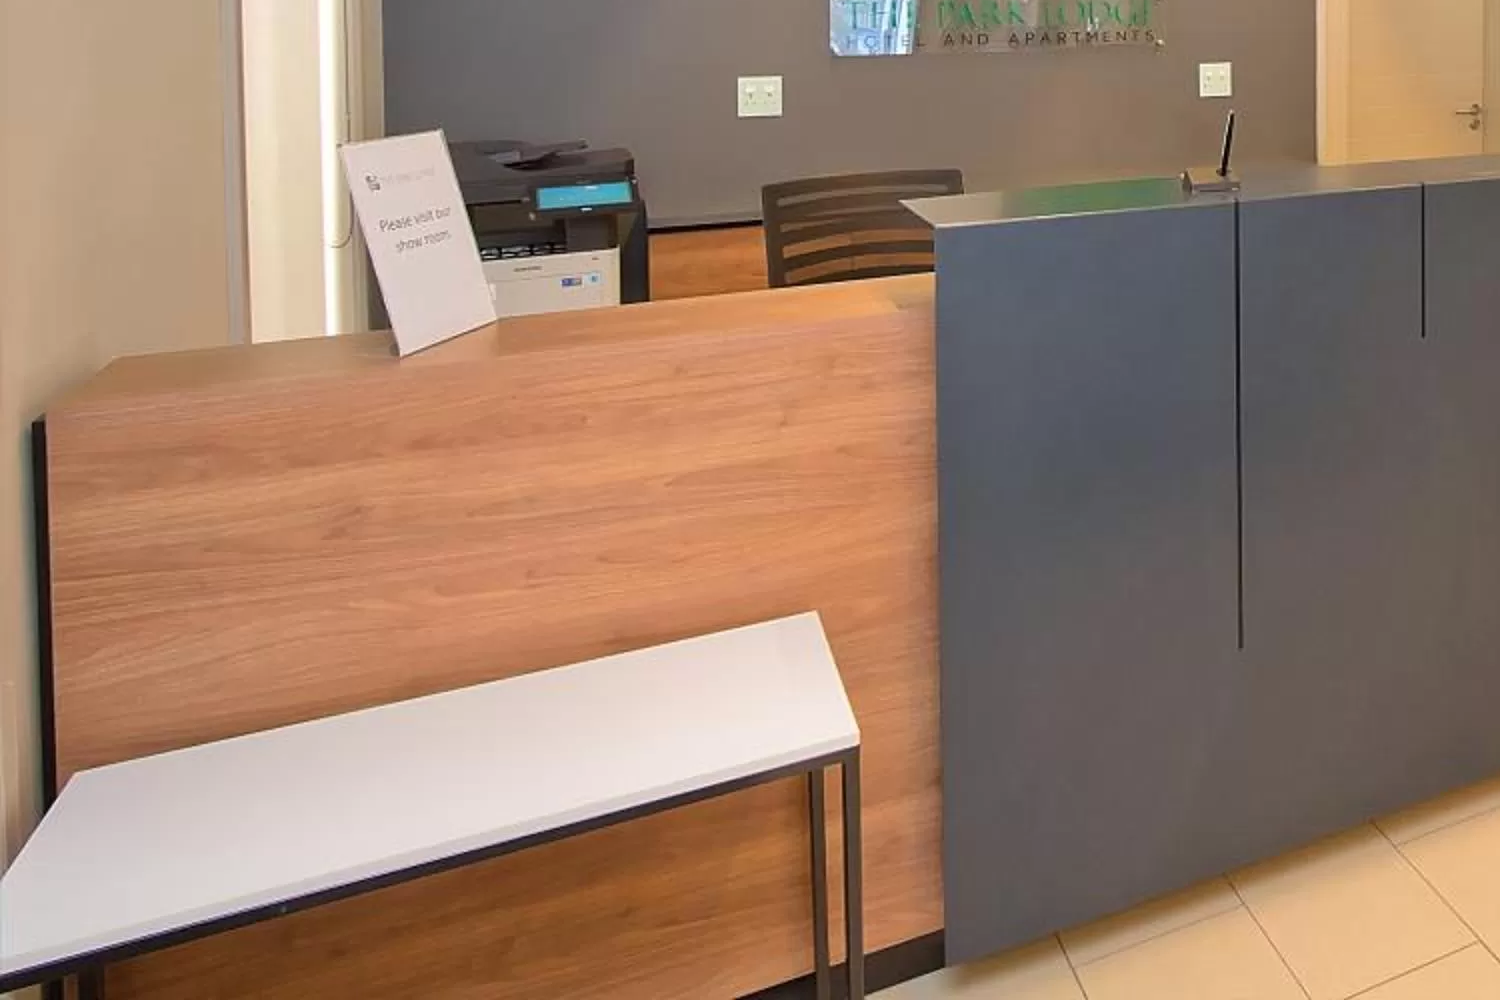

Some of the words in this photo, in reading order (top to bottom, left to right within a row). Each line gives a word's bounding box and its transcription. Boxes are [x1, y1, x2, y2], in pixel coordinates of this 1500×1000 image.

[846, 0, 918, 29] THE
[846, 31, 927, 49] HOTEL
[943, 32, 990, 47] AND
[1007, 29, 1155, 48] APARTMENTS
[379, 215, 413, 232] Please
[413, 209, 435, 224] visit
[435, 206, 451, 219] our
[395, 237, 422, 252] show
